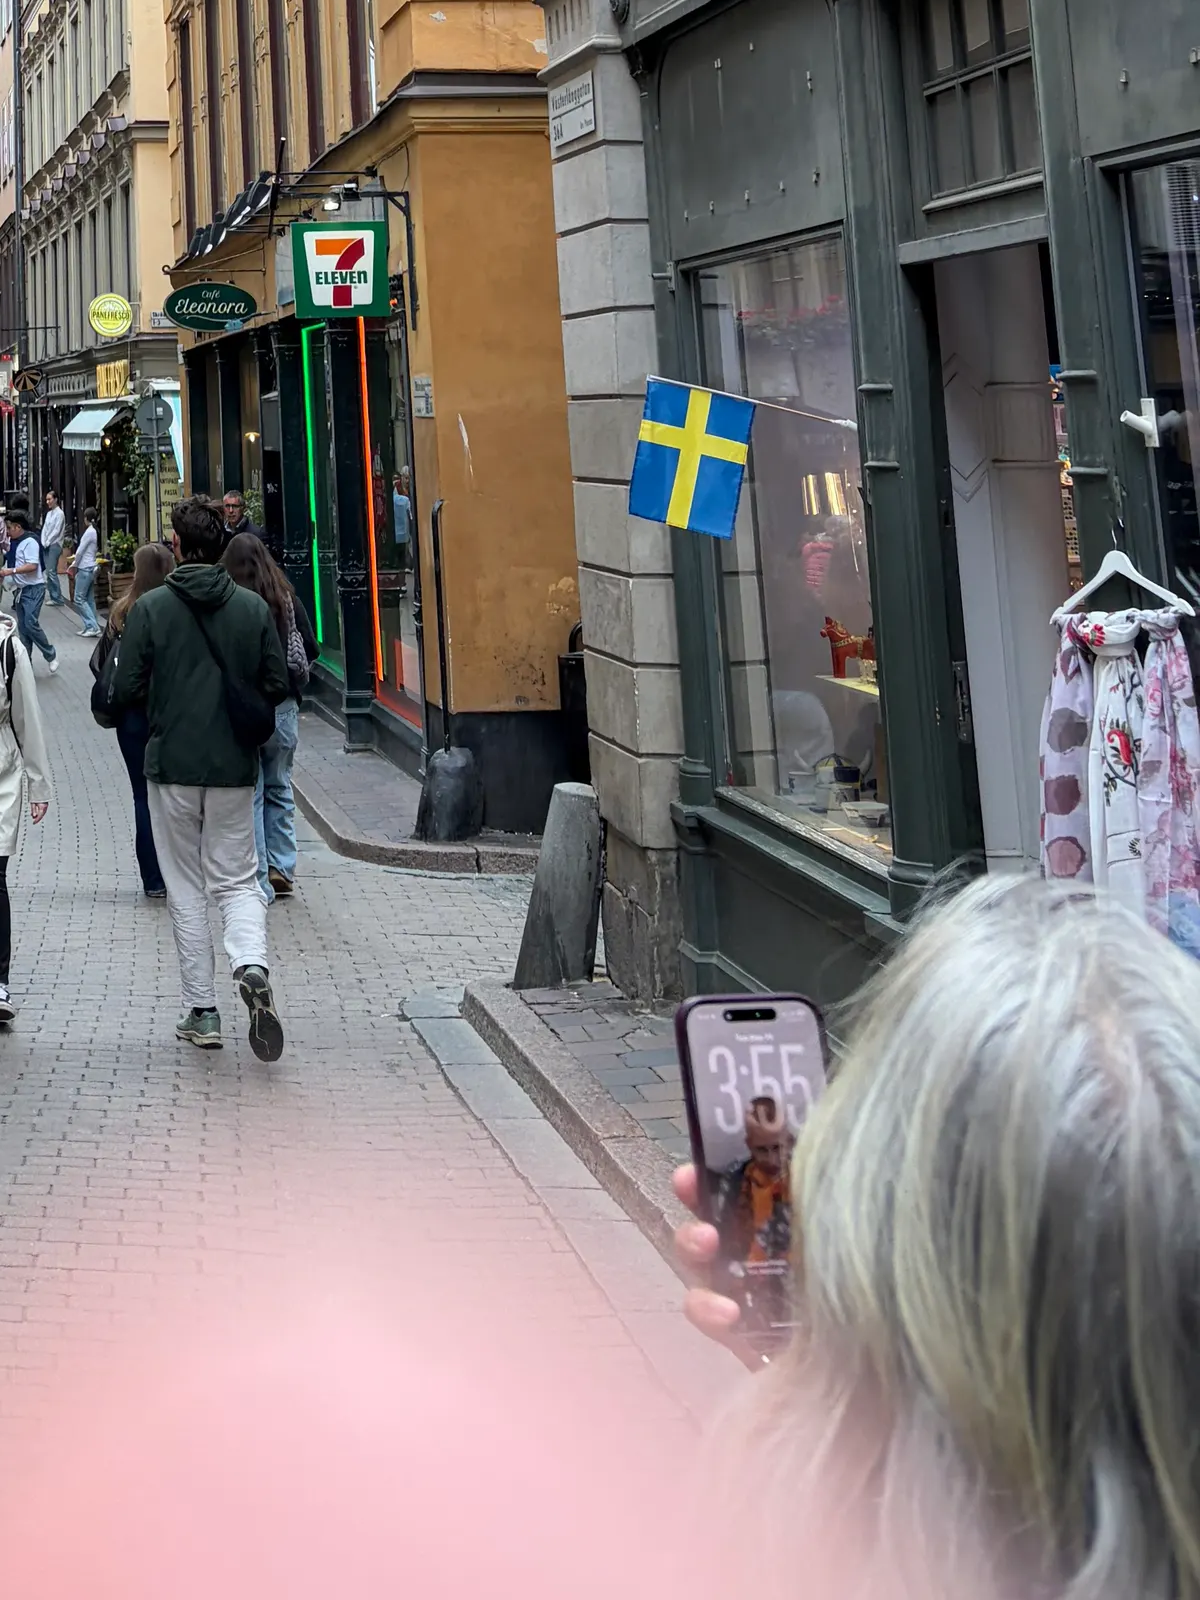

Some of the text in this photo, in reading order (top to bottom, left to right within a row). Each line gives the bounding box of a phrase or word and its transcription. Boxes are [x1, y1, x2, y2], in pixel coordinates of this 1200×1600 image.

[315, 237, 366, 307] 7
[174, 298, 248, 315] Eleonora
[201, 289, 221, 299] Café
[708, 1043, 813, 1134] 3:55
